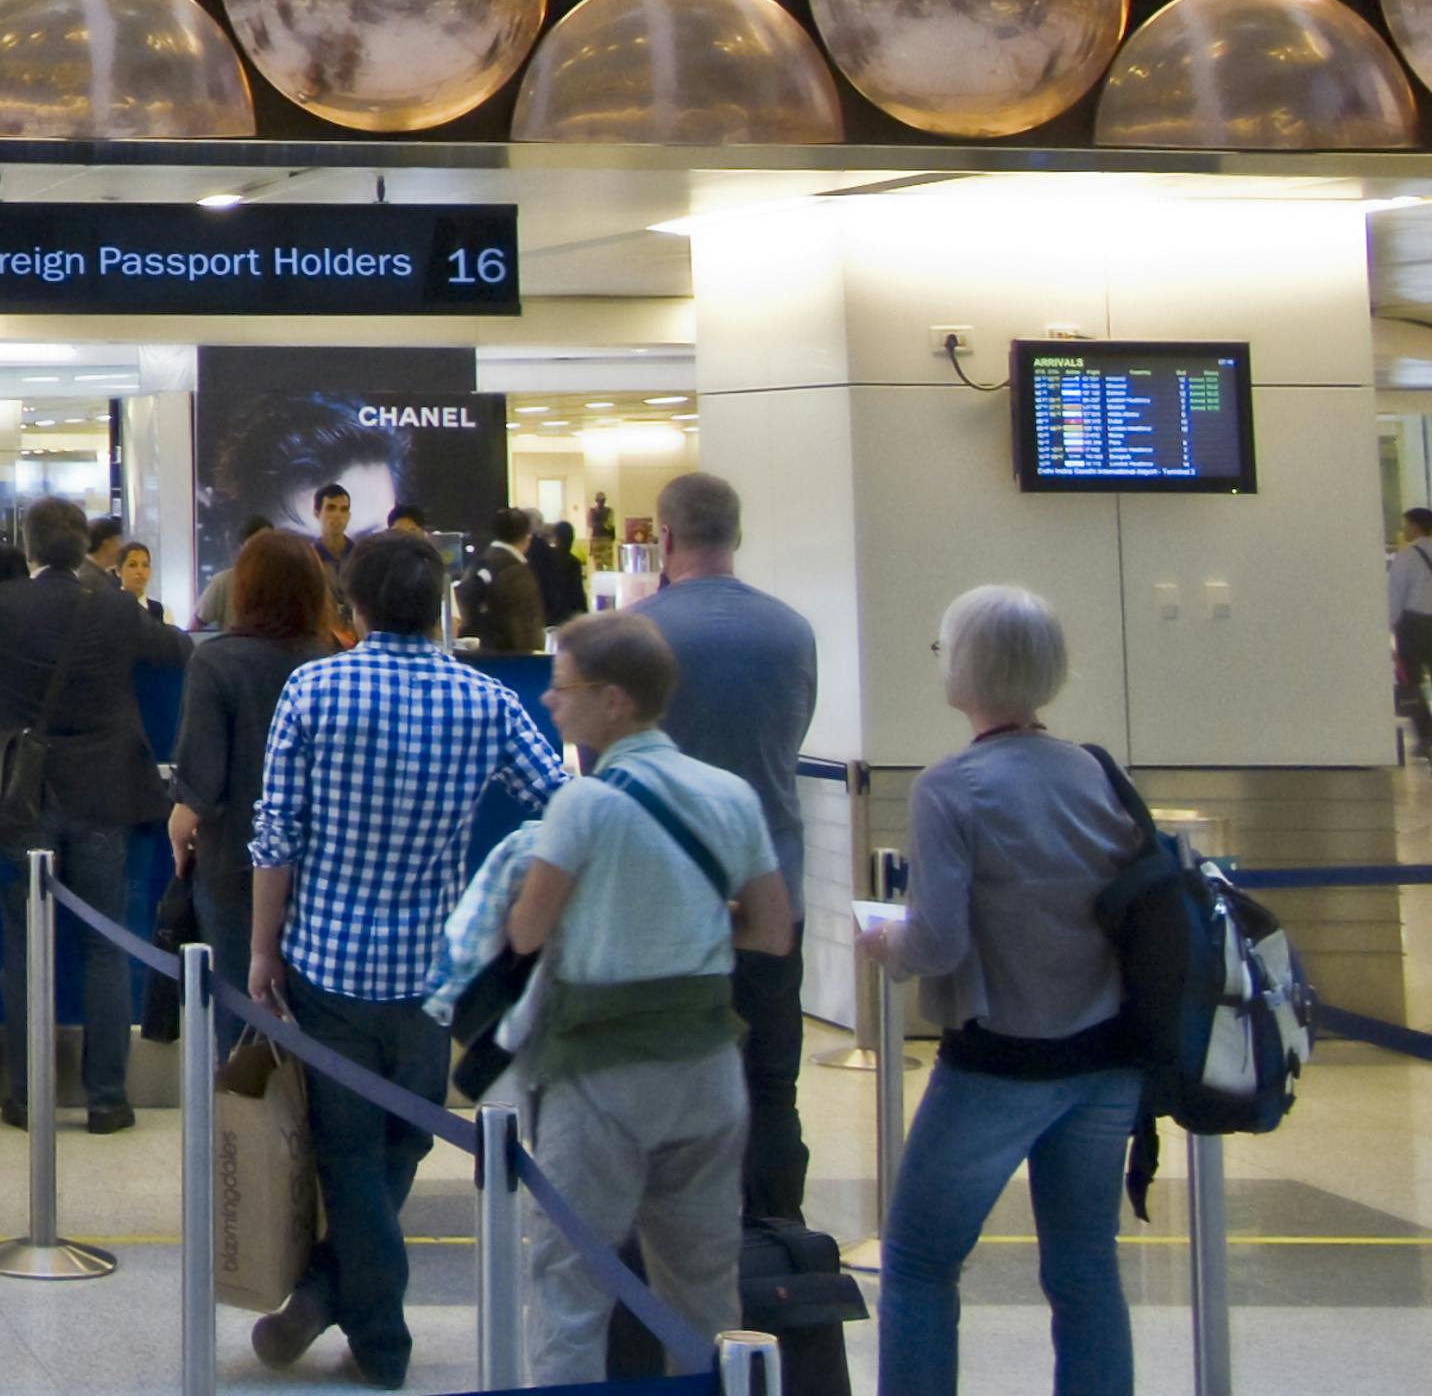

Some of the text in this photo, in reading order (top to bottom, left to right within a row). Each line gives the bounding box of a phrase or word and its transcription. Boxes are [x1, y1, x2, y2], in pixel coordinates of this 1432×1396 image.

[99, 247, 261, 281] Passport
[274, 247, 412, 276] Holders
[448, 248, 507, 283] 16
[1034, 357, 1084, 367] ARRIVALS
[358, 406, 476, 427] CHANEL
